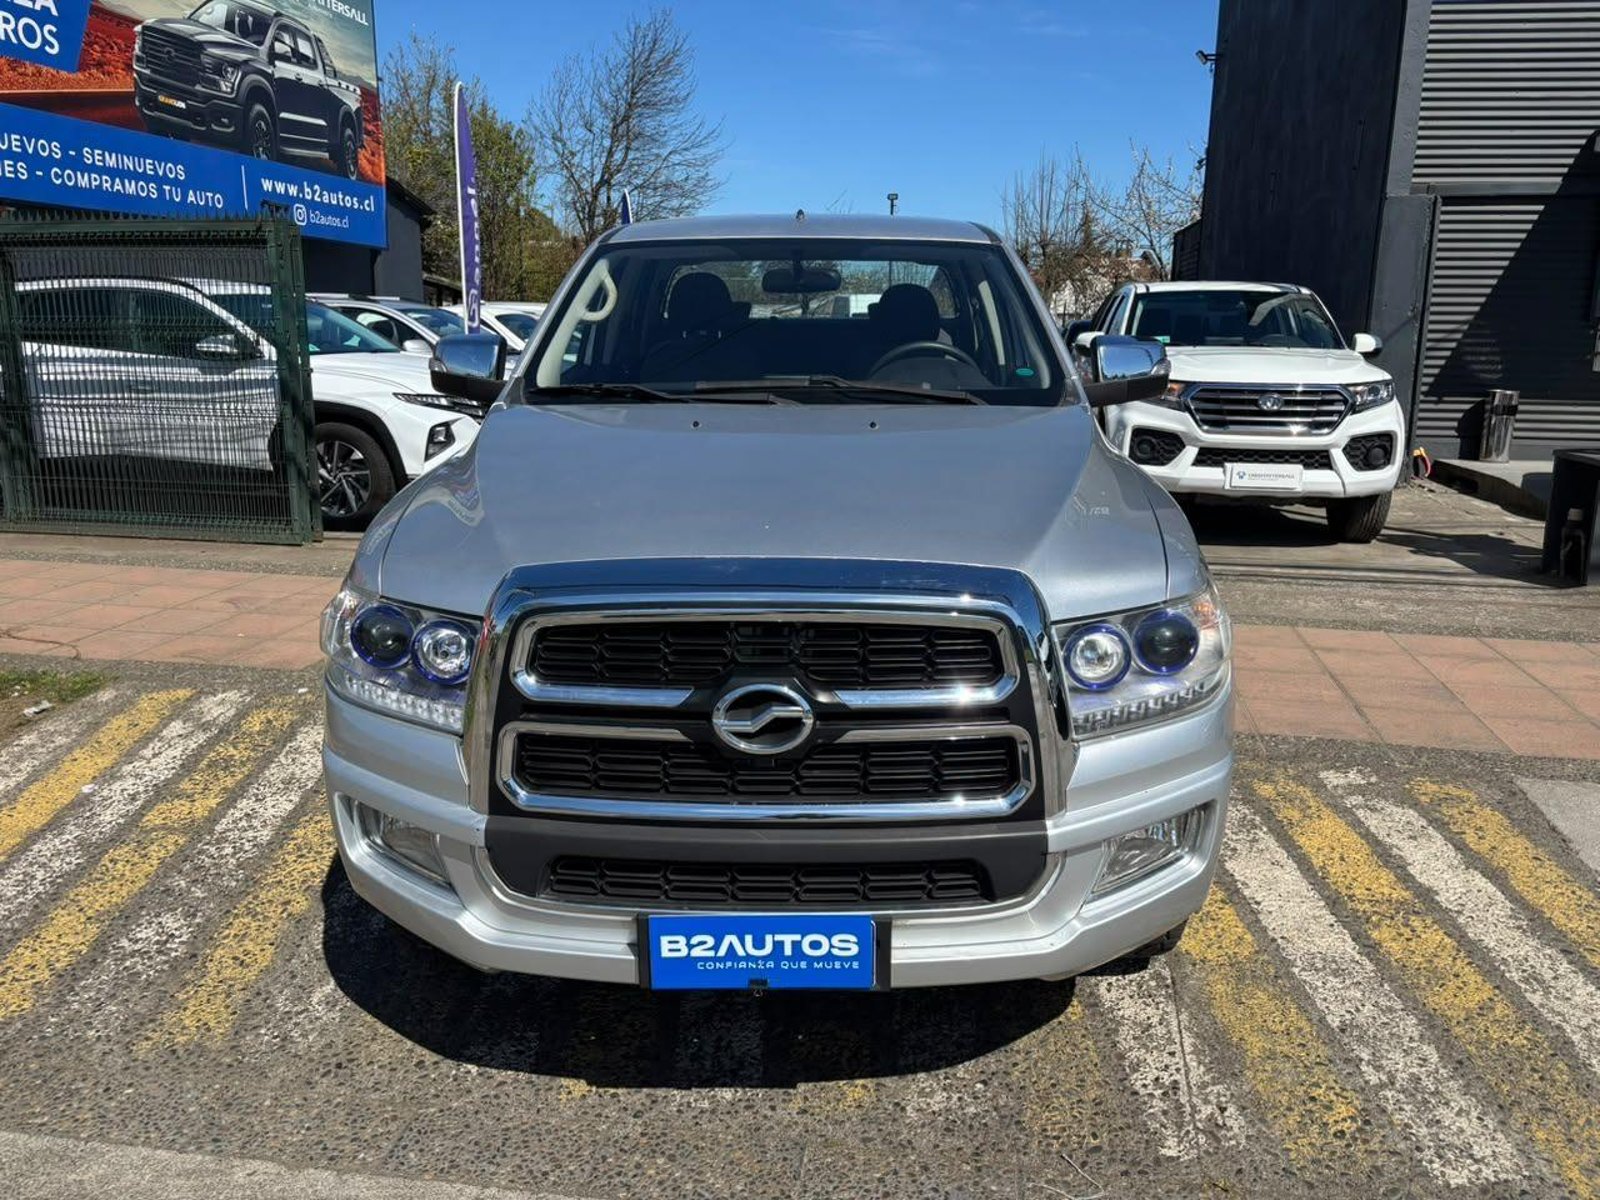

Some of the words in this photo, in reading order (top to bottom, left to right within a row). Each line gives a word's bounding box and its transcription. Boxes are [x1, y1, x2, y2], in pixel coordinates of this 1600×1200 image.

[82, 146, 186, 181] SEMINUEVOS
[0, 159, 28, 180] ES
[50, 166, 158, 199] COMPRAMOS
[162, 184, 181, 202] TU
[186, 189, 224, 209] AUTO
[260, 177, 375, 213] www.b2autos.cl
[309, 209, 350, 229] b2autos.cl
[659, 933, 860, 958] B2AUTOS
[697, 960, 775, 970] CONFIANZA
[780, 960, 808, 970] QUE
[813, 960, 860, 970] MUEVE
